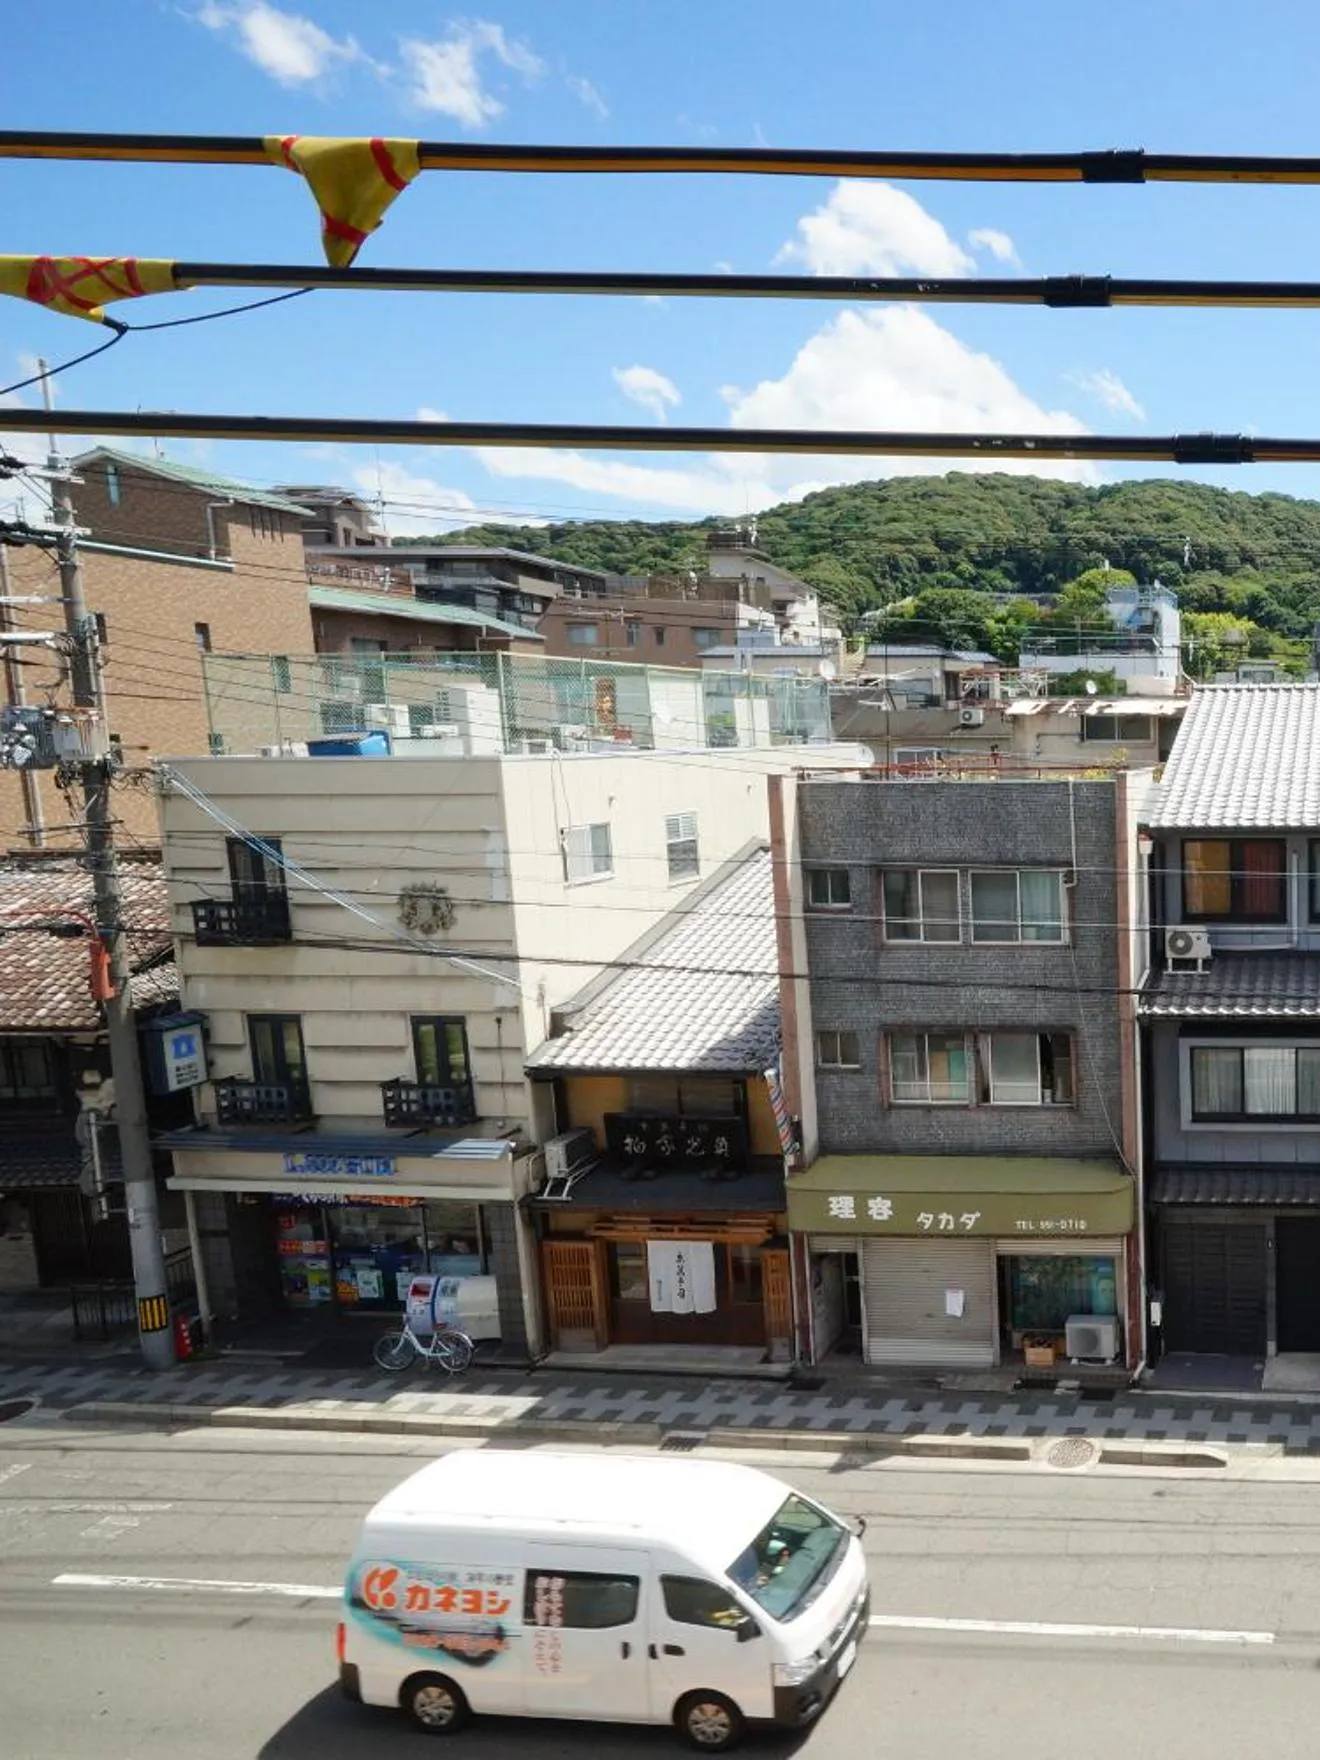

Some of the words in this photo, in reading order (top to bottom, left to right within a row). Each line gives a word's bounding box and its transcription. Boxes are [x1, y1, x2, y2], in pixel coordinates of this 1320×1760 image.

[828, 1196, 893, 1221] 理容
[917, 1212, 981, 1231] タカダ
[1014, 1220, 1035, 1230] TEL
[404, 1585, 512, 1616] カネヨシ
